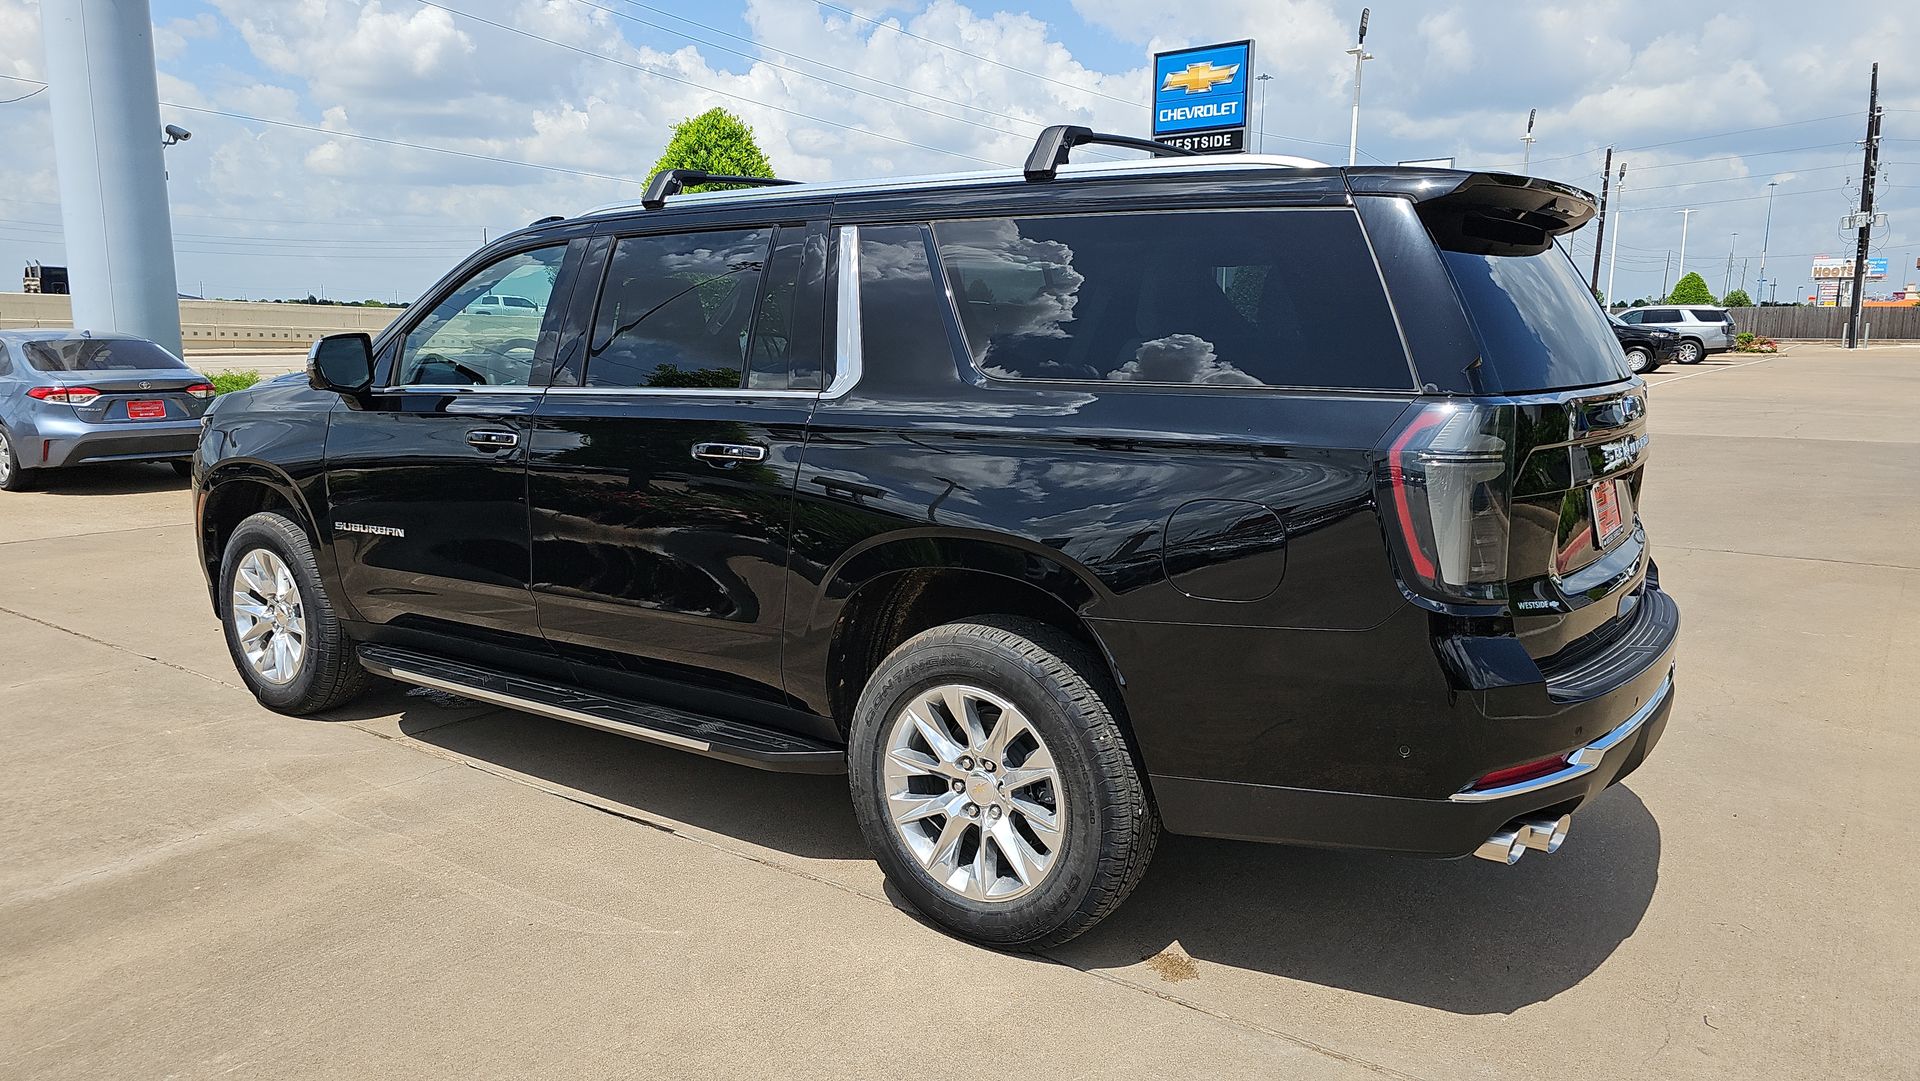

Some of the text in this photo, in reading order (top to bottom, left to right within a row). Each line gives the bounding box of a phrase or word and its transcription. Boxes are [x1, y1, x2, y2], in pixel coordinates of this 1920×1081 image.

[1160, 102, 1238, 122] CHEVROLET
[334, 521, 405, 538] SUBURBAN
[1517, 601, 1549, 610] WESTSIDE
